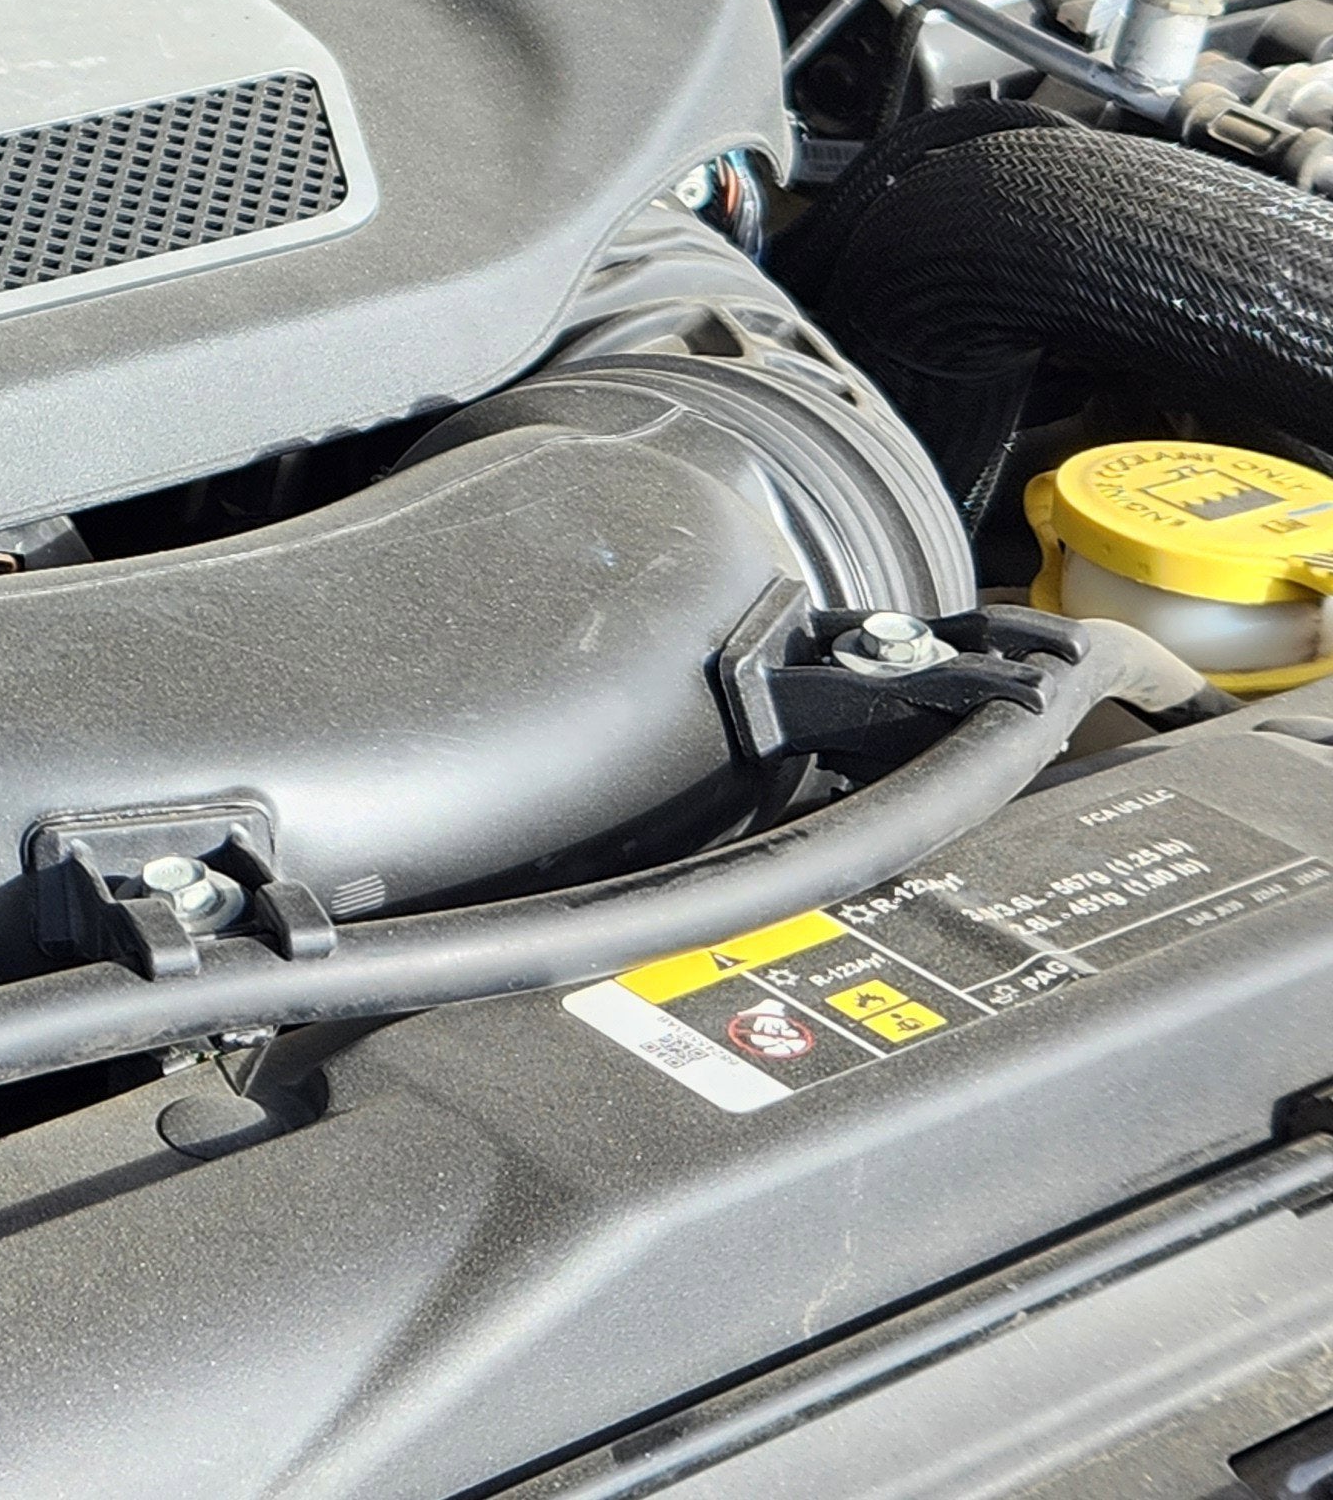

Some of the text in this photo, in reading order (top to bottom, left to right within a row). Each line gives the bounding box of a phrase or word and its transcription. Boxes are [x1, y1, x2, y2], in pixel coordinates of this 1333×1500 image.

[1232, 461, 1314, 491] ONLY
[1079, 789, 1176, 827] FCA US LLC
[1050, 871, 1112, 895] 567g
[1105, 850, 1162, 876] (1.25
[1067, 890, 1128, 917] 451g
[1121, 867, 1178, 897] (1.00
[1021, 960, 1070, 991] PAG
